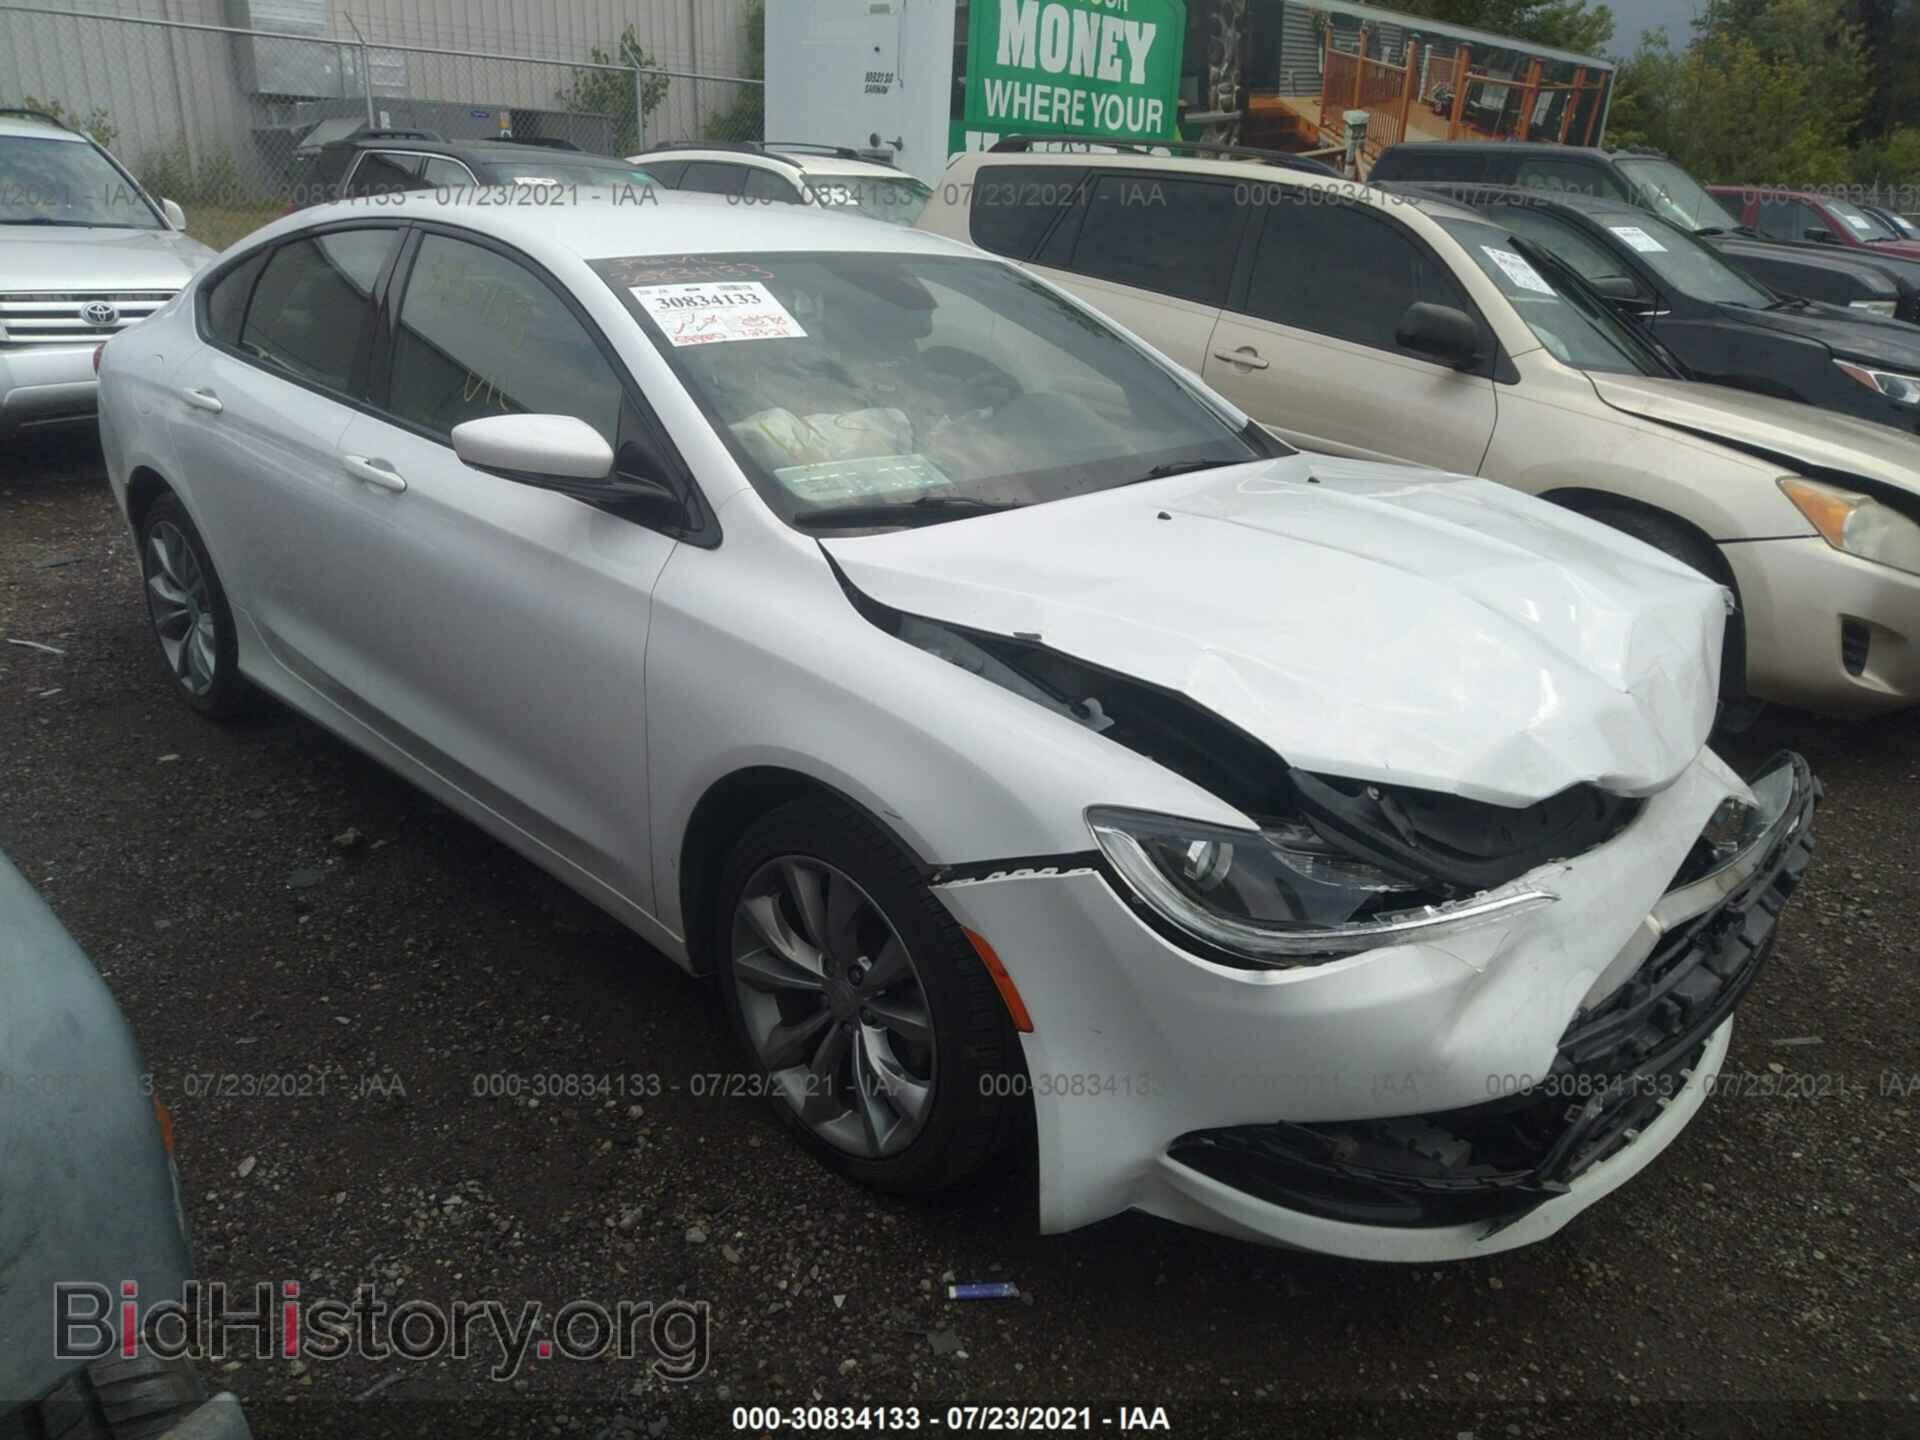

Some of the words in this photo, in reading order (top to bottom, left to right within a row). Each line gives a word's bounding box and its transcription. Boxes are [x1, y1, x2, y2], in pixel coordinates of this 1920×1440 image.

[996, 0, 1157, 85] MONEY
[984, 78, 1087, 127] WHERE
[1091, 91, 1164, 134] YOUR
[655, 292, 762, 310] 30834133
